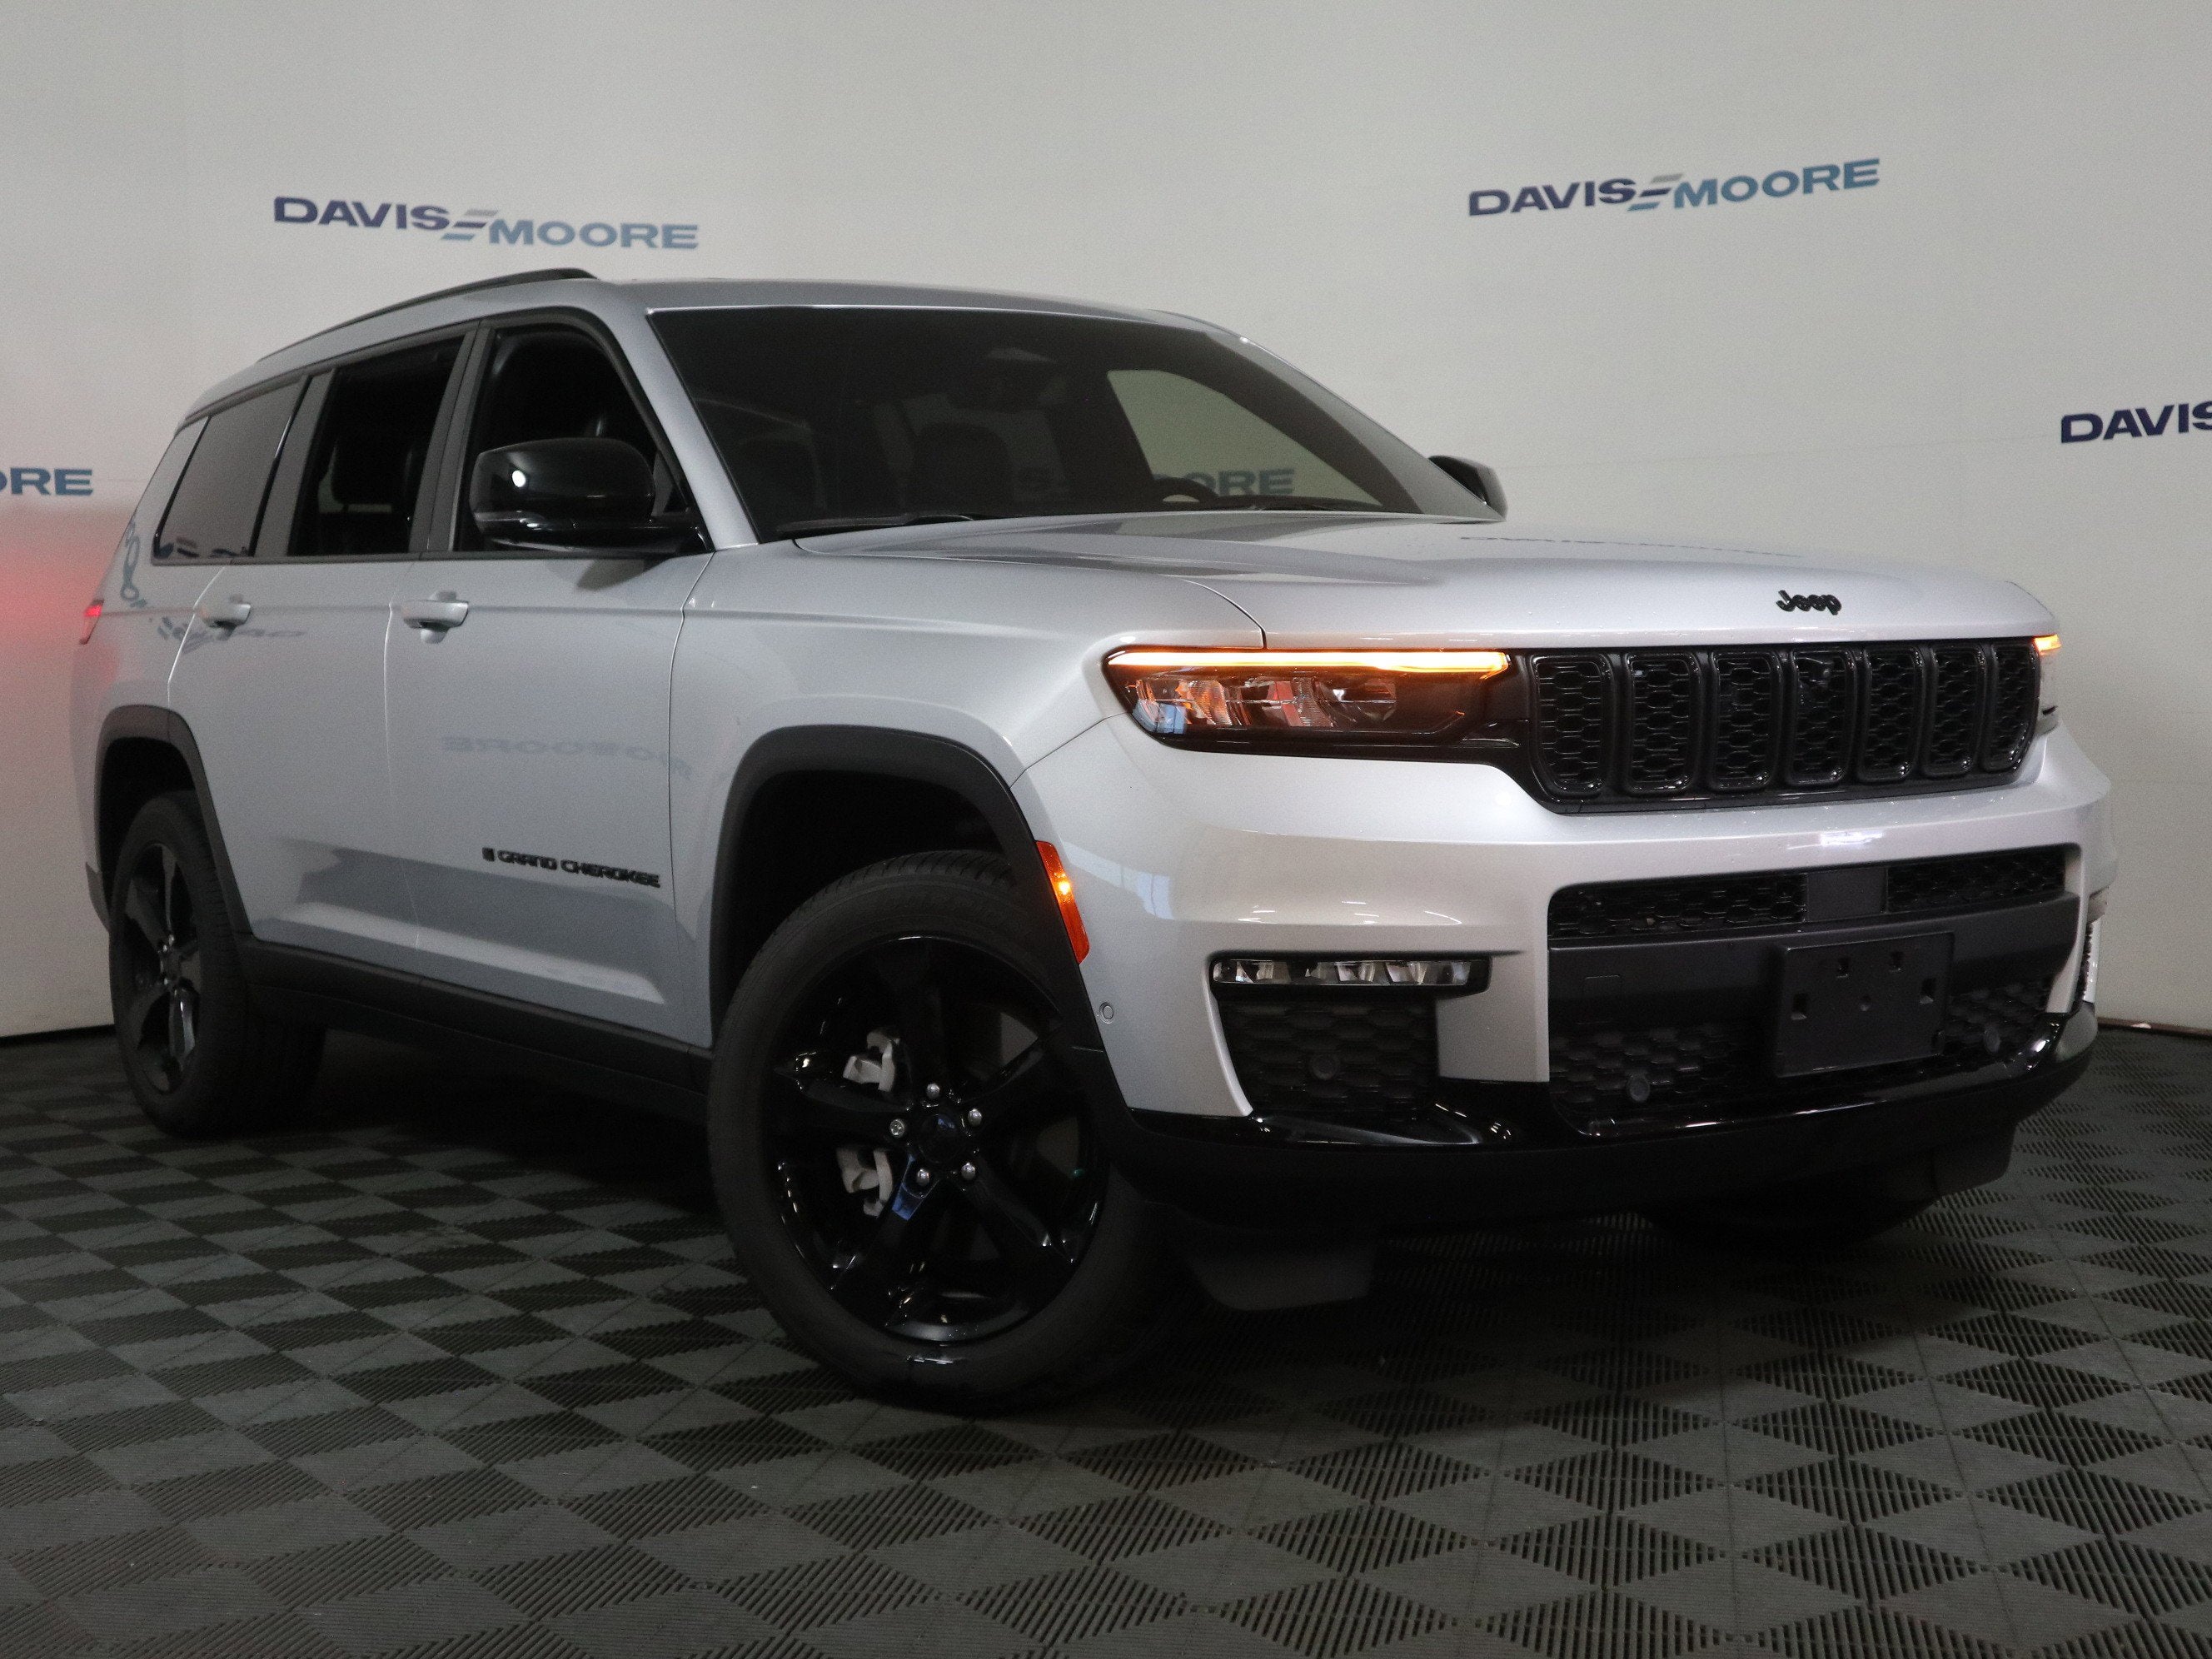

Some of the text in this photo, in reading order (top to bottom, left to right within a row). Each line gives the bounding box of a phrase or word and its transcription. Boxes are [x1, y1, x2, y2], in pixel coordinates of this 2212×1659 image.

[1469, 158, 1881, 217] DAVIS MOORE
[273, 196, 699, 250] DAVIS MOORE
[0, 466, 93, 496] RE
[1776, 590, 1842, 615] Jeep
[497, 849, 660, 889] GRAND CHEROKEE
